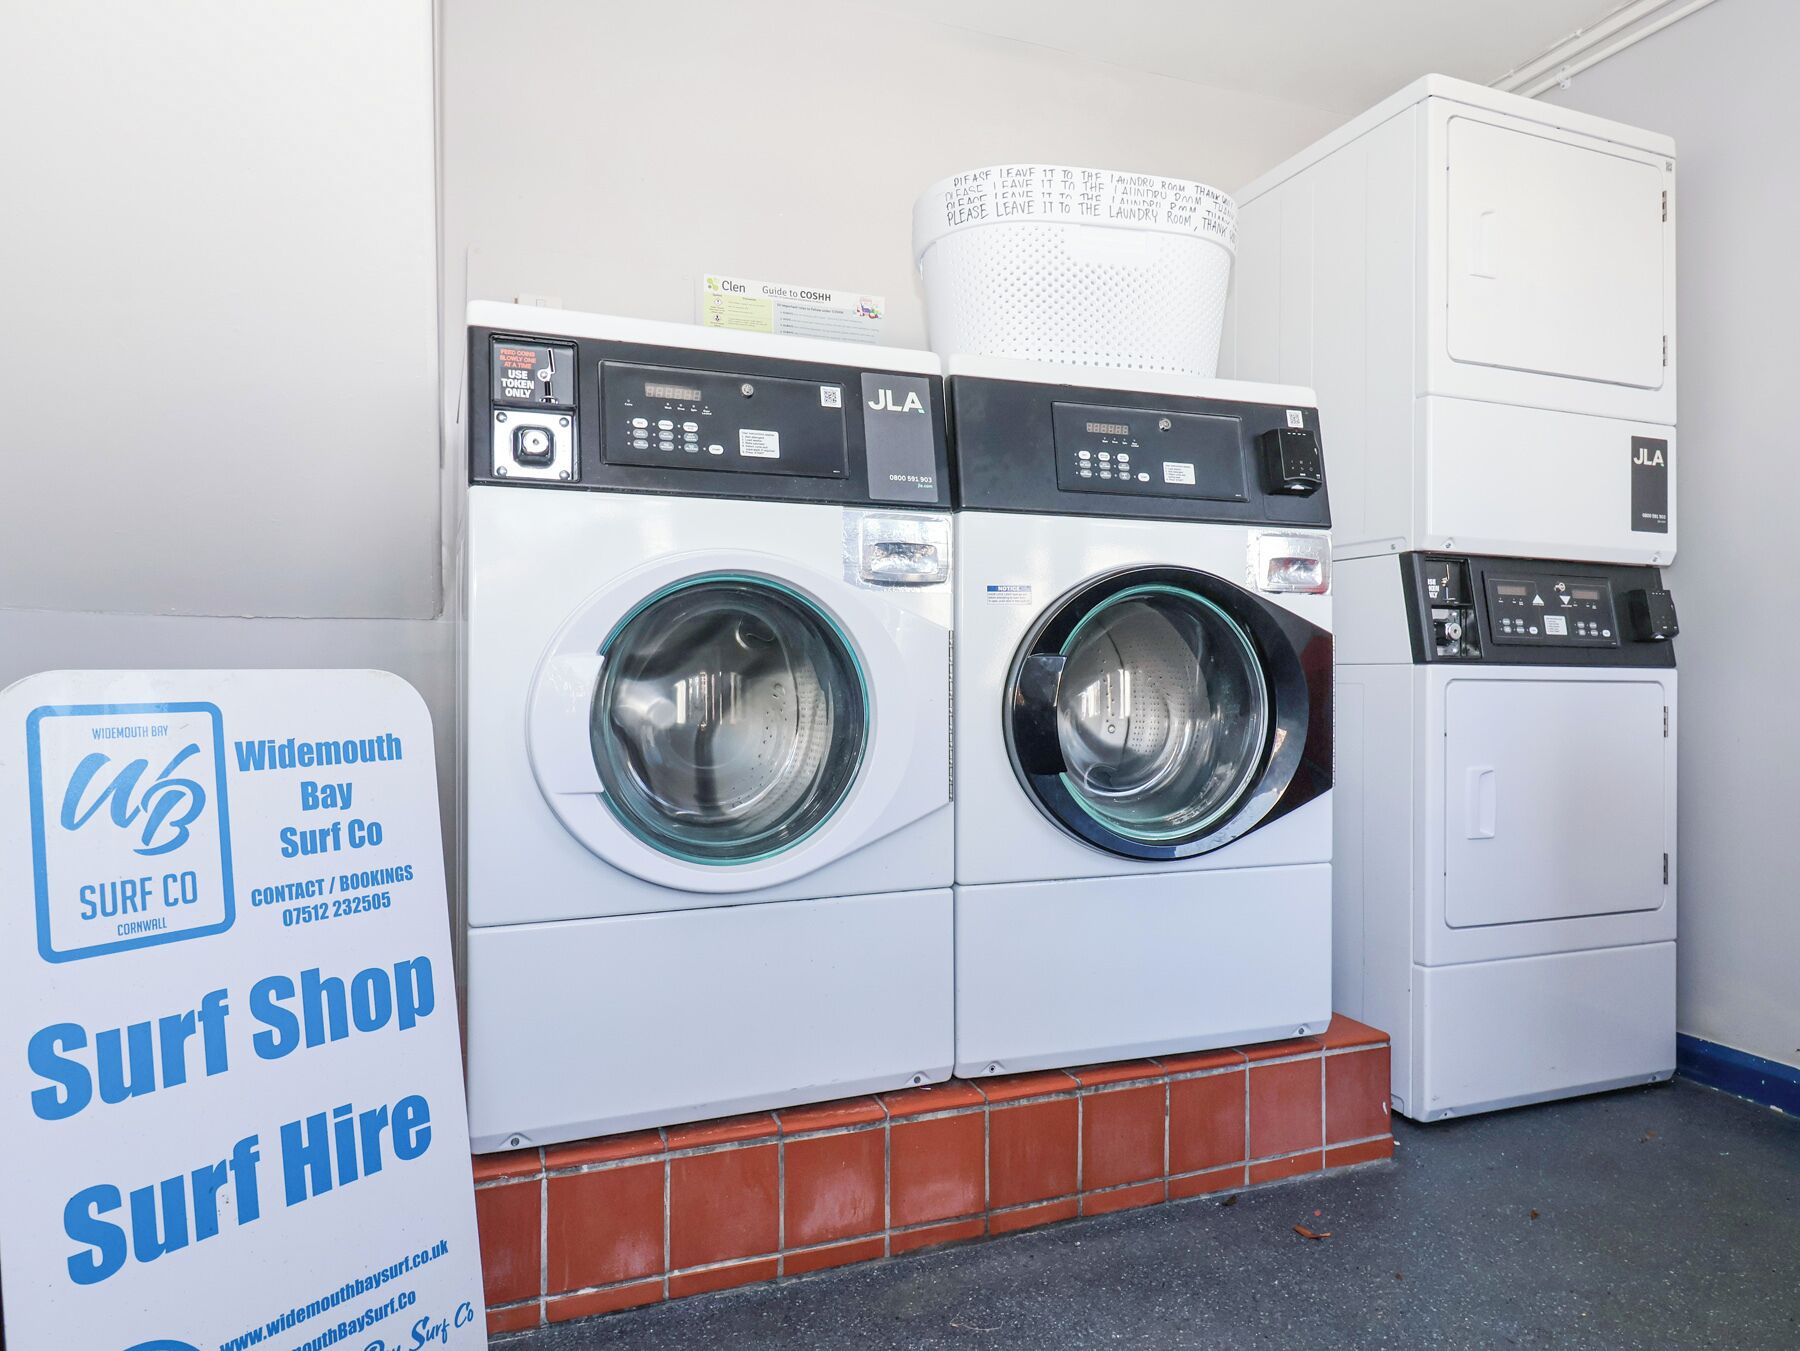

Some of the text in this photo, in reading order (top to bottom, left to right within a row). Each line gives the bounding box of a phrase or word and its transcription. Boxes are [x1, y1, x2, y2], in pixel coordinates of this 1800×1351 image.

[947, 203, 989, 226] PLEASE
[995, 200, 1034, 217] LEAVE
[1043, 201, 1053, 214] IT
[1059, 201, 1071, 214] TO
[1078, 202, 1101, 216] THE
[1109, 205, 1158, 223] LAUNDRY
[721, 280, 746, 293] Clen
[762, 285, 787, 297] Guide
[789, 290, 798, 298] to
[800, 290, 831, 301] COSHH
[501, 378, 534, 390] TOKEN
[508, 369, 528, 379] USE
[505, 387, 531, 399] ONLY
[868, 389, 925, 413] JLA
[1633, 447, 1664, 467] JLA
[889, 474, 907, 482] 0800
[92, 725, 168, 740] WIDEMOUTH BAY
[234, 733, 403, 772] Widemouth
[300, 780, 353, 811] Bay
[280, 818, 383, 858] Surf Co
[79, 870, 198, 920] SURF CO
[251, 878, 325, 907] CONTACT
[339, 864, 414, 892] BOOKINGS
[282, 891, 391, 927] 07512 232505
[117, 917, 167, 936] CORNWALL
[27, 955, 435, 1121] Surf Shop
[63, 1094, 432, 1285] Surf Hire
[220, 1239, 449, 1351] www.widemouthbaysurf.co.uk
[409, 1301, 474, 1351] Surf Co
